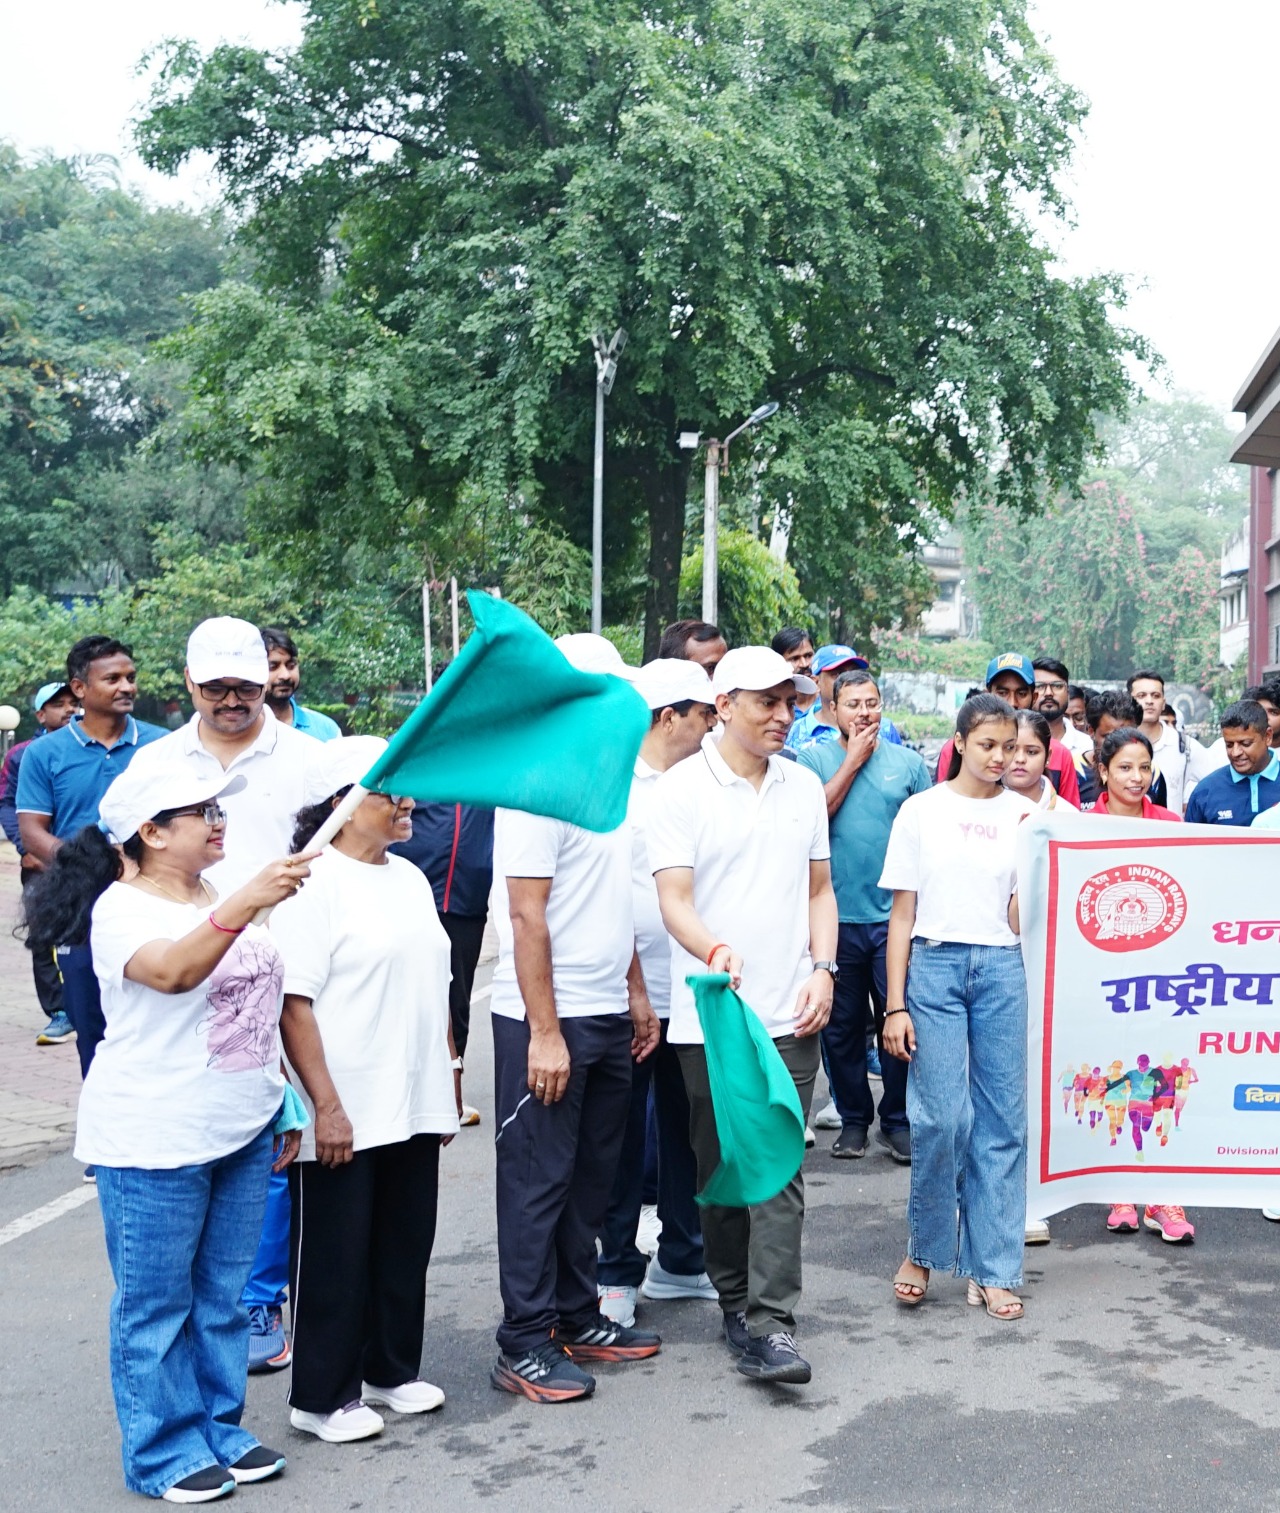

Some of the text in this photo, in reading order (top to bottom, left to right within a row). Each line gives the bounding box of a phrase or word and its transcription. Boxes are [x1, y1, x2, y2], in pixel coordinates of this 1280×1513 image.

[1128, 866, 1184, 933] INDIAN RAILWAYS
[1199, 1031, 1280, 1055] RUN
[1217, 1146, 1279, 1156] Divisional
